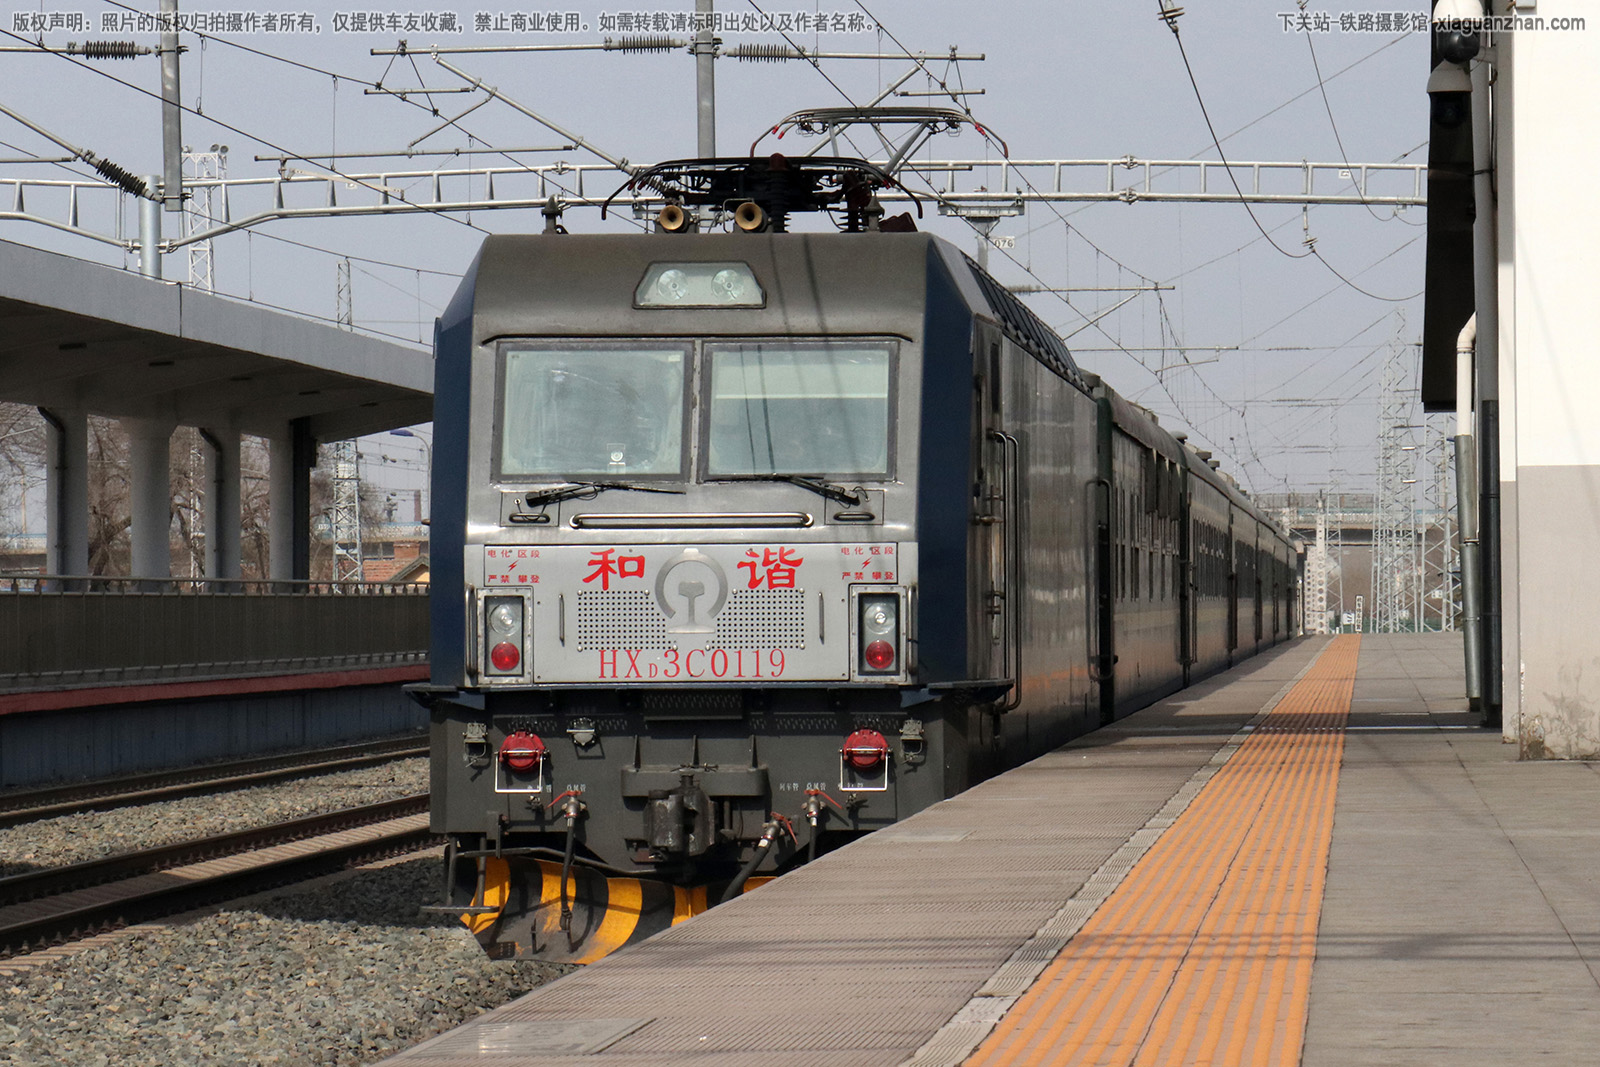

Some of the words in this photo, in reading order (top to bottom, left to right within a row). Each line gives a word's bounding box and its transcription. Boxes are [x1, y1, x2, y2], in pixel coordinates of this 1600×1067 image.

[582, 548, 645, 591] 和
[736, 546, 804, 590] 谐
[598, 649, 786, 679] HXD3C0119
